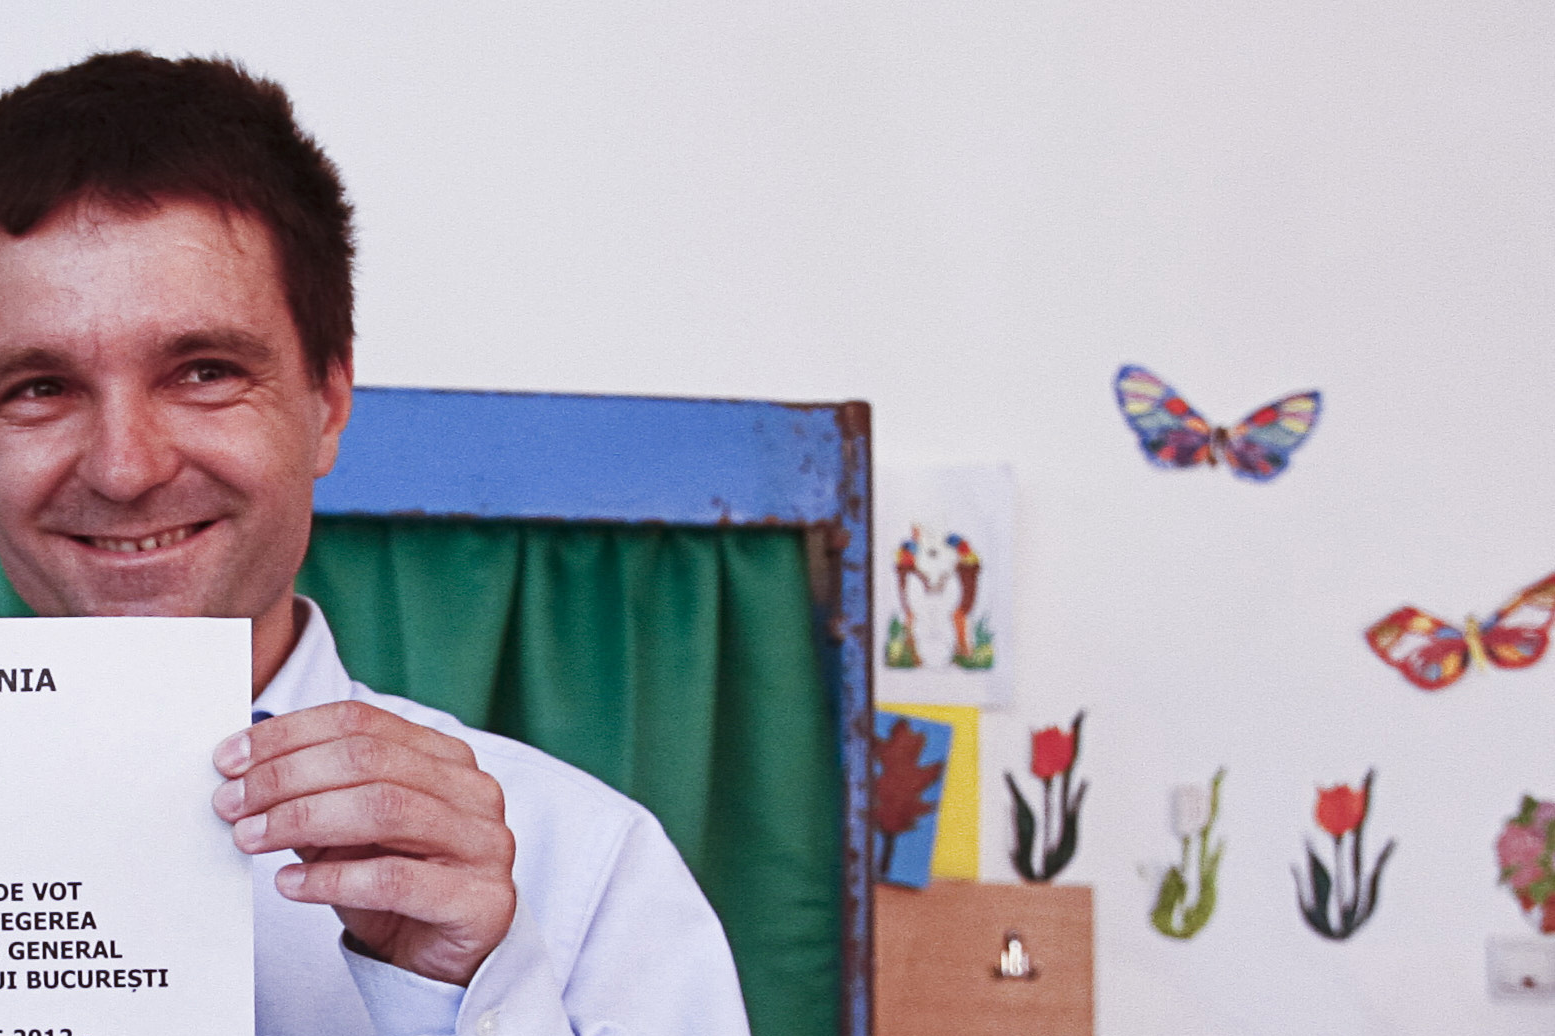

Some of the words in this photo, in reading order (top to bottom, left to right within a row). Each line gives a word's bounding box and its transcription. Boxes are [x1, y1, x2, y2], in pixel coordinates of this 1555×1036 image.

[32, 882, 83, 901] VOT
[8, 940, 123, 960] GENERAL
[27, 969, 169, 993] BUCUREȘTI
